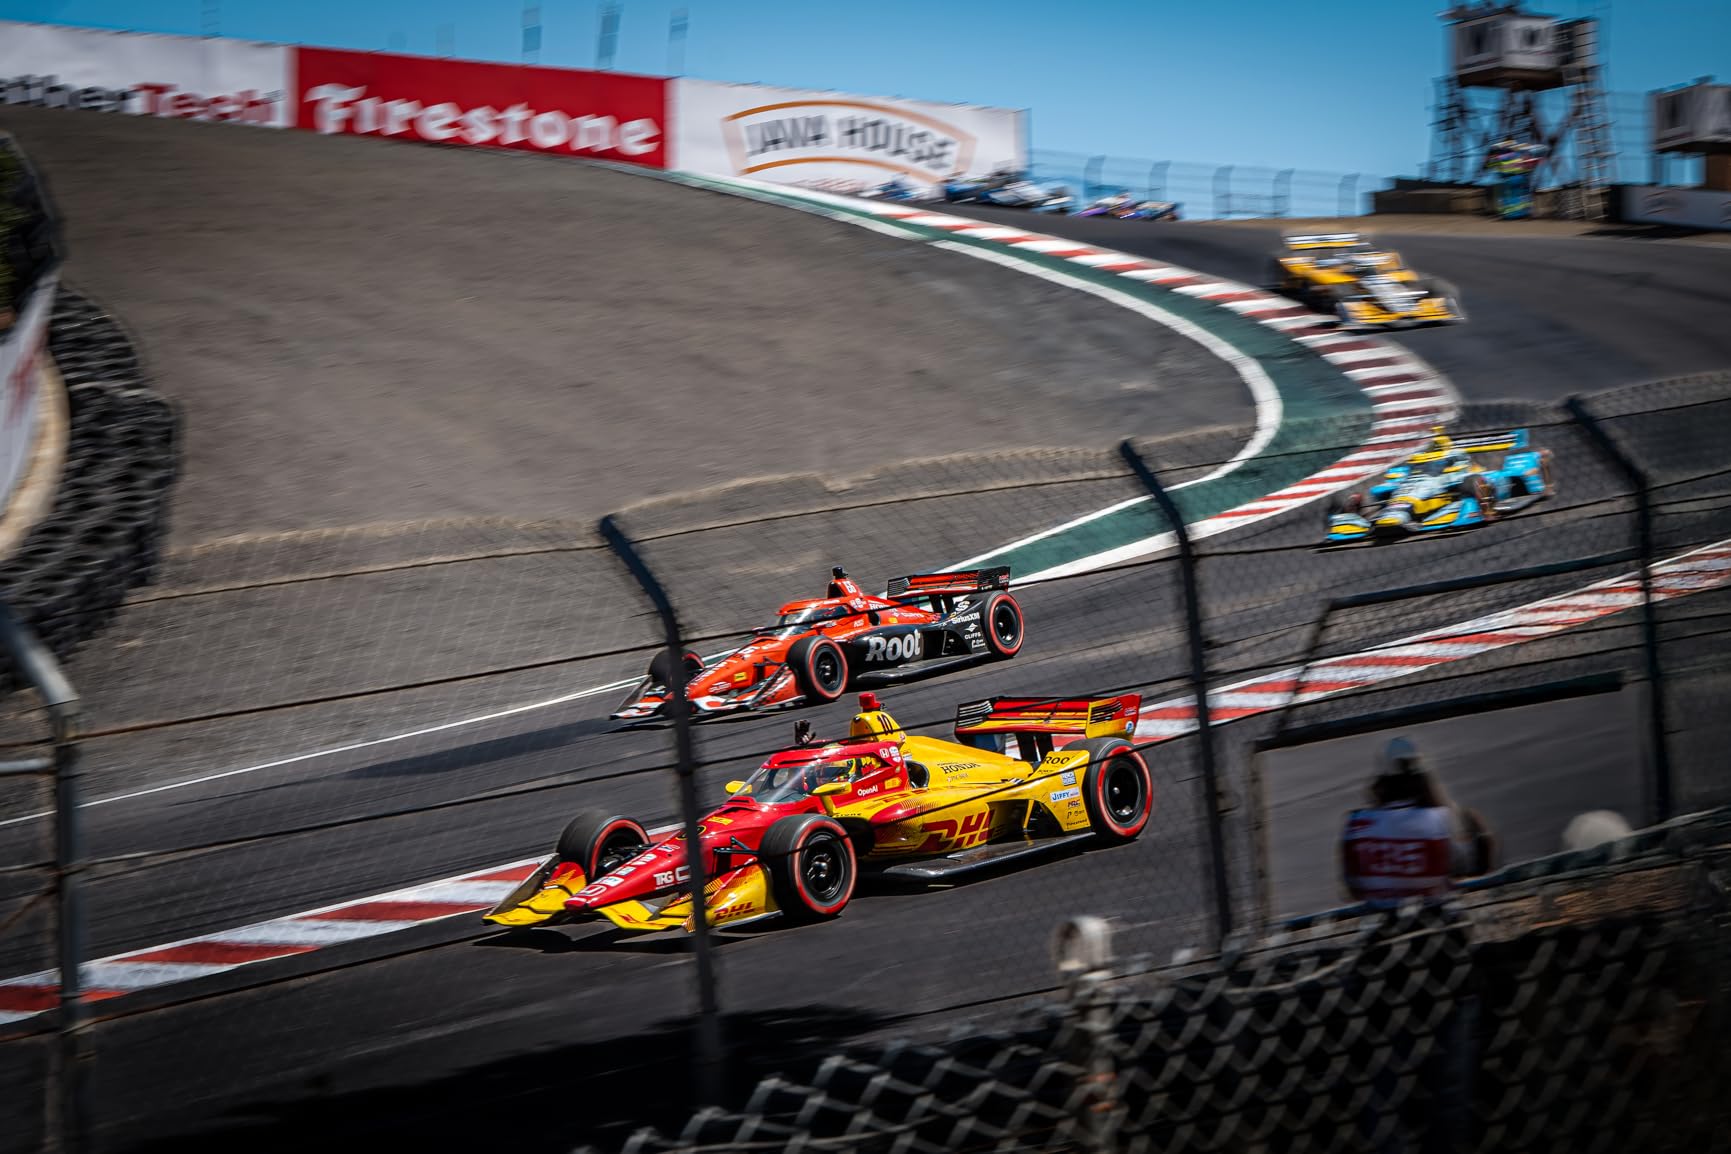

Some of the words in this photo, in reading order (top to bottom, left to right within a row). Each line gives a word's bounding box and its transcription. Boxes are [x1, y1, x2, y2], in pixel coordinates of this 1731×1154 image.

[0, 75, 274, 122] therTech
[304, 83, 661, 156] Firestone
[745, 115, 831, 157] JAVA
[837, 116, 956, 170] HOUSE
[951, 612, 980, 624] SiriusXM
[865, 629, 921, 661] Root
[877, 713, 893, 735] 10
[940, 761, 981, 775] HONDA
[1043, 756, 1075, 765] ROO
[857, 784, 879, 797] OpenAI
[917, 809, 998, 851] DHL
[653, 870, 674, 885] TRG
[714, 901, 755, 920] DHL
